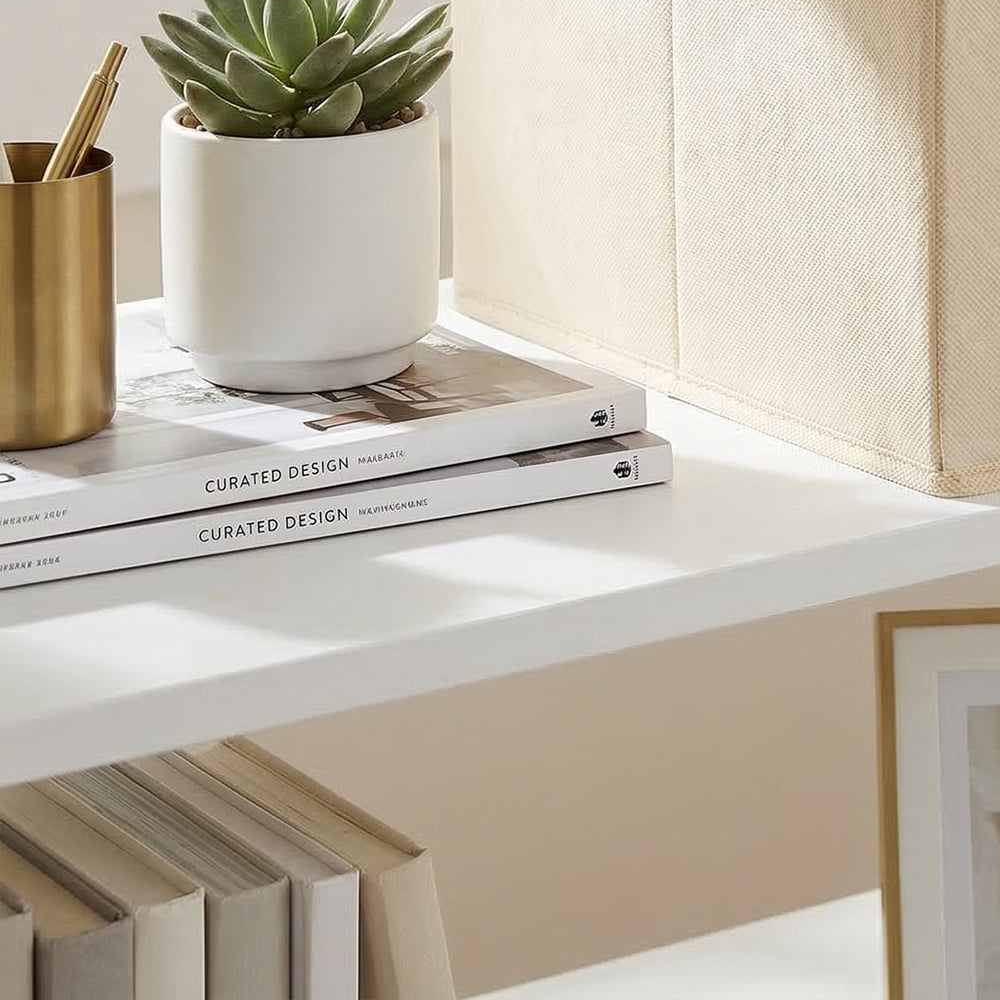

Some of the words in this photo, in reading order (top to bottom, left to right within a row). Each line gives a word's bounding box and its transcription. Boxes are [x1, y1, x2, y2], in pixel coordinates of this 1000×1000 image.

[204, 468, 282, 493] CURATED
[288, 457, 350, 480] DESIGN
[198, 518, 279, 543] CURATED
[285, 507, 348, 530] DESIGN
